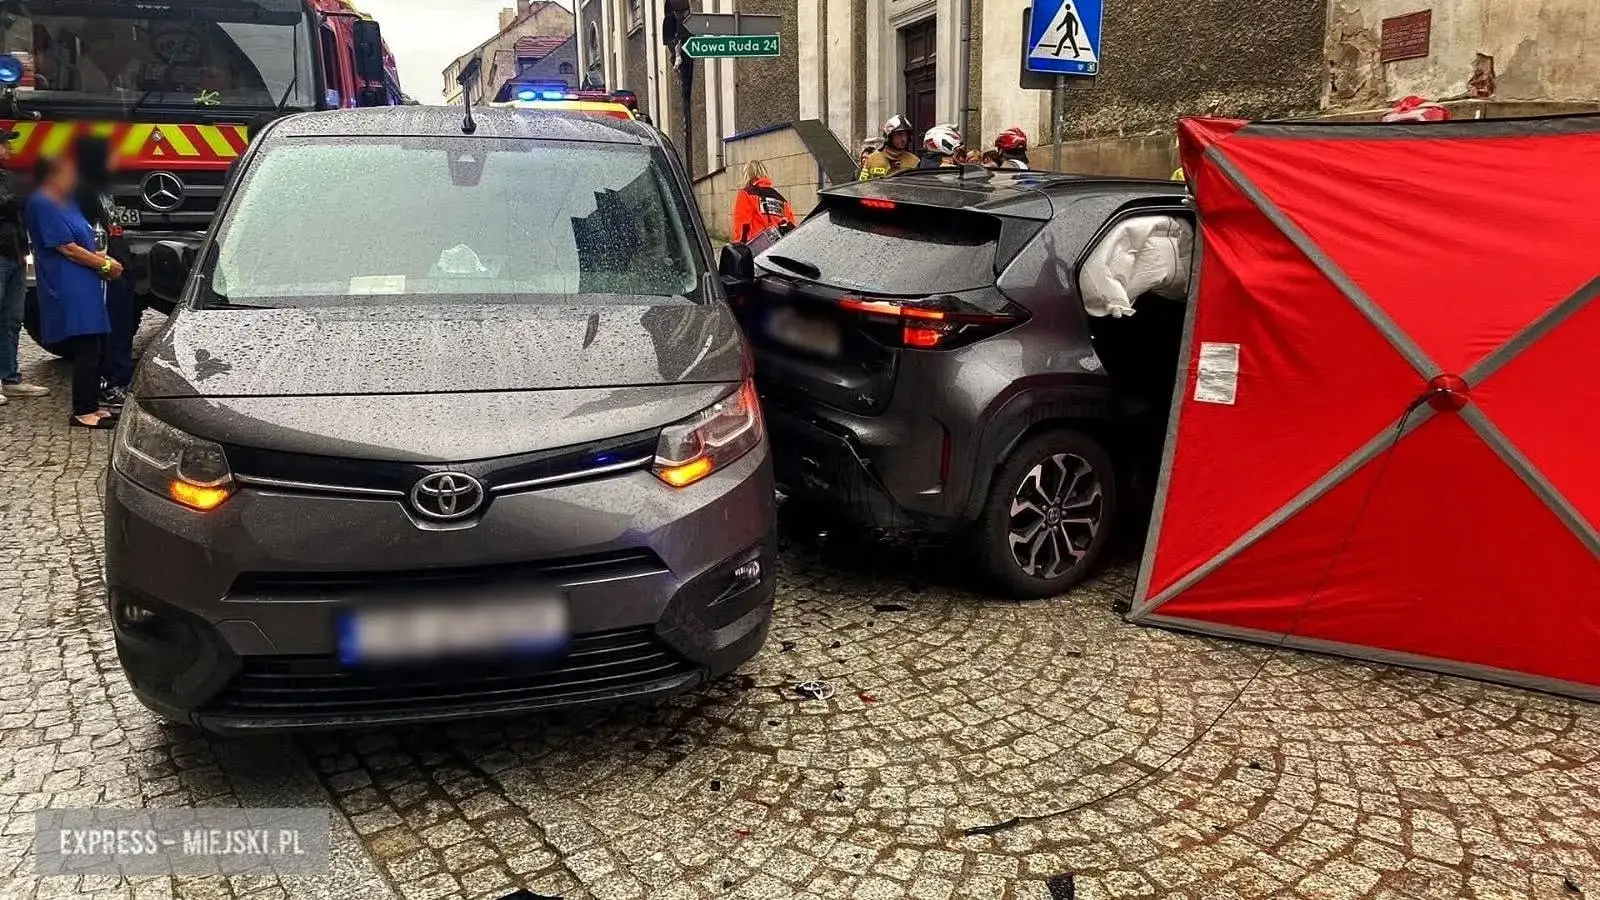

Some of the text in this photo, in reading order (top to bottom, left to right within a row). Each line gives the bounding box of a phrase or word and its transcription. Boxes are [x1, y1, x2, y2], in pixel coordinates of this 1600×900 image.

[691, 39, 777, 52] Nowa Ruda 24
